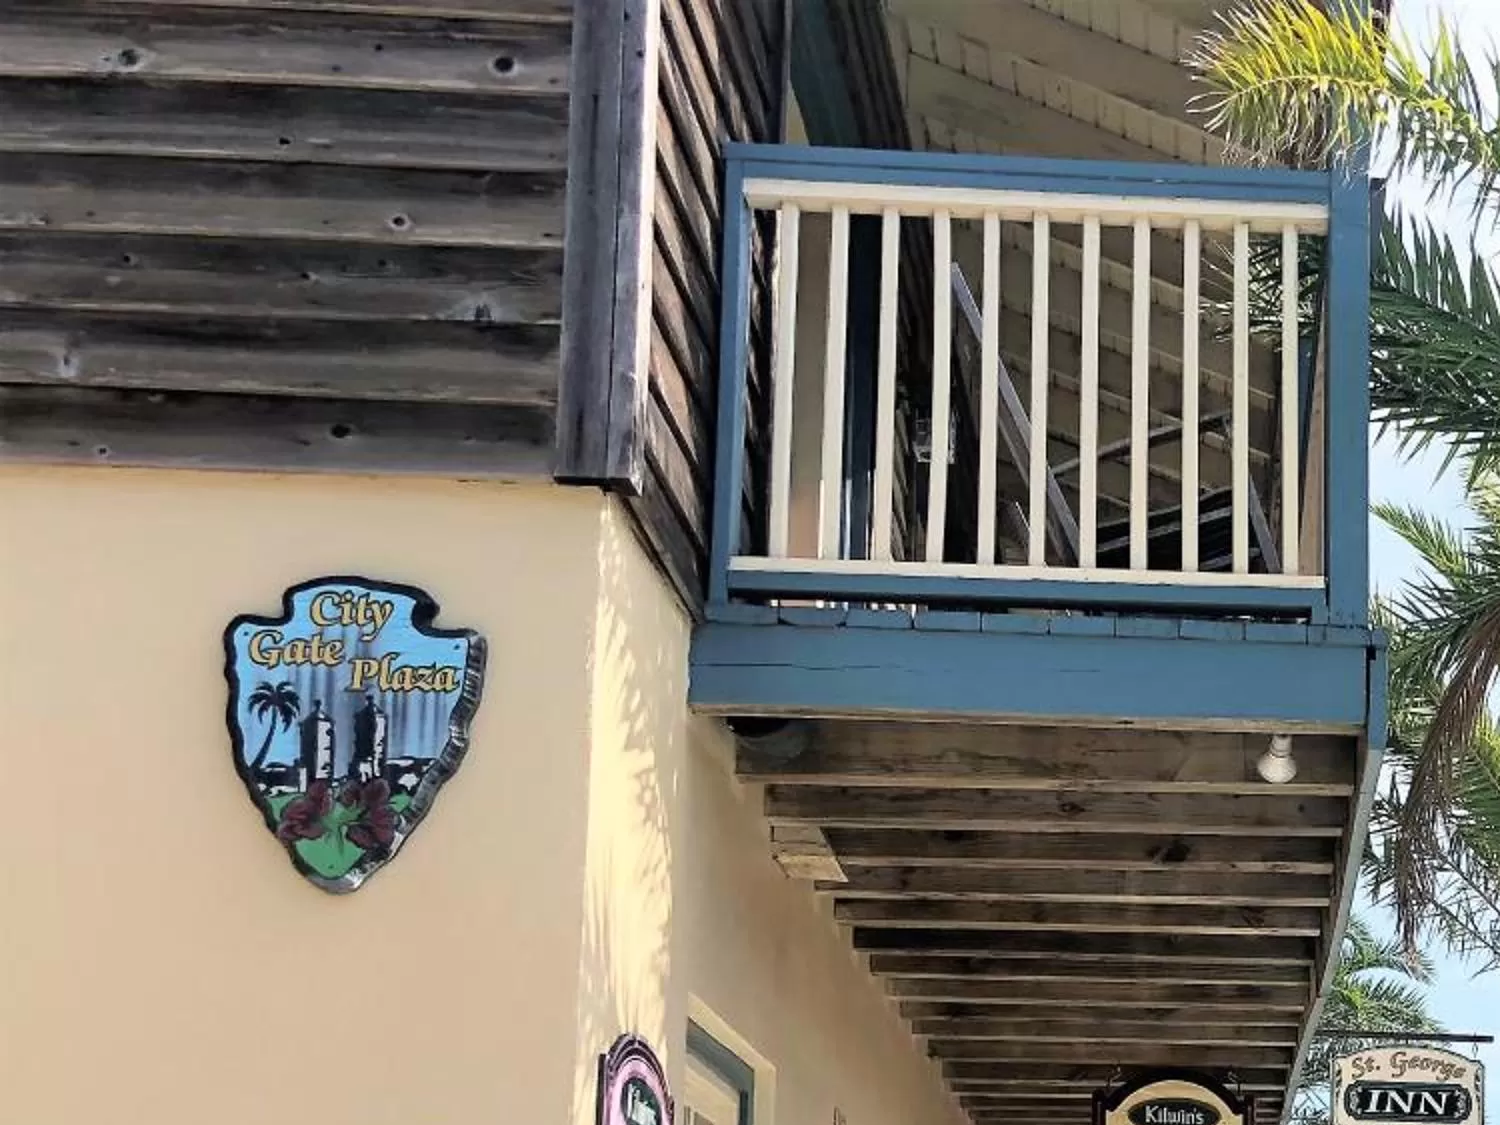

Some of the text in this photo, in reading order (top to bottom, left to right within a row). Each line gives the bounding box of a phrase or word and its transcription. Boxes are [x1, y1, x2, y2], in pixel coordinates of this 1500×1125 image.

[309, 590, 395, 642] City
[250, 629, 344, 669] Gate
[346, 651, 463, 693] Plaza
[1351, 1051, 1467, 1082] St. George
[1363, 1089, 1452, 1116] INN
